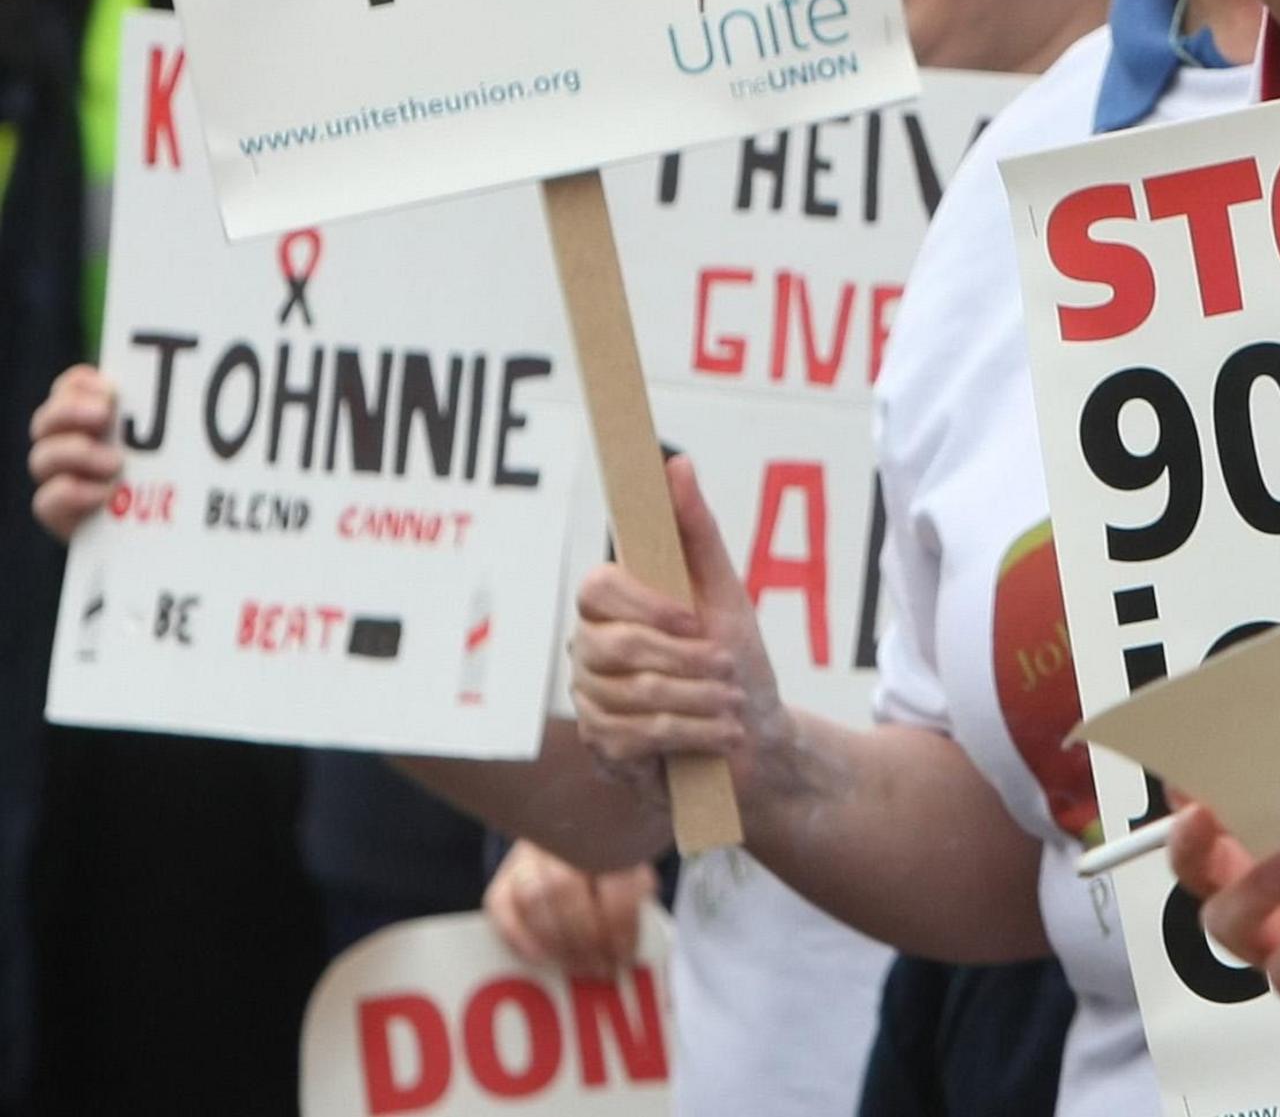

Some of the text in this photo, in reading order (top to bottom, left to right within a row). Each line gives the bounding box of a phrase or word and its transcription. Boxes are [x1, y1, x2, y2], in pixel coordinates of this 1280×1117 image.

[238, 66, 582, 156] www.unitetheunion.org
[122, 330, 554, 488] JOHNNIE
[153, 590, 201, 648] BE
